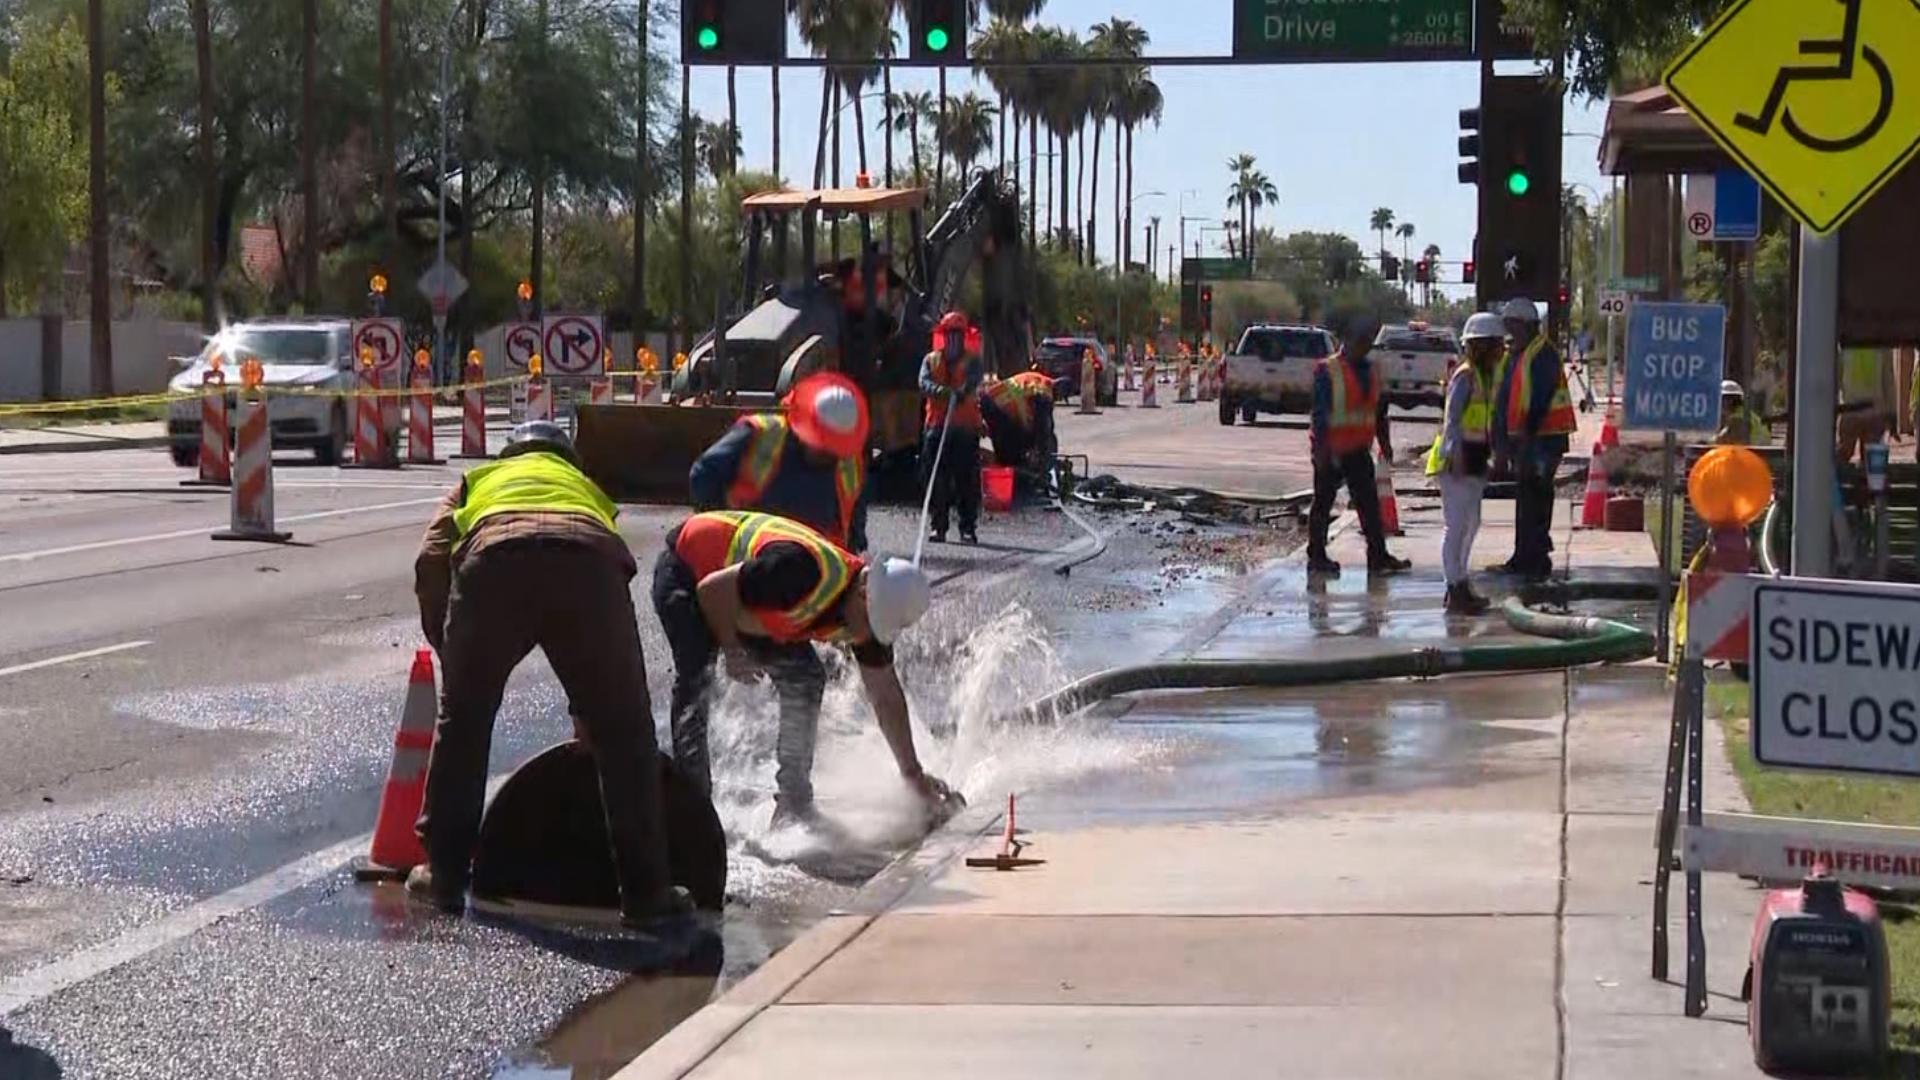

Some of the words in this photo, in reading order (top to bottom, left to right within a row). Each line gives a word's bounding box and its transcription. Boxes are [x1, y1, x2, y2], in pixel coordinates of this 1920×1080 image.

[1264, 14, 1336, 40] Drive
[1601, 299, 1624, 312] 40
[1651, 316, 1699, 341] BUS
[1643, 353, 1704, 378] STOP
[1634, 389, 1708, 418] MOVED
[1781, 692, 1918, 745] CLOS
